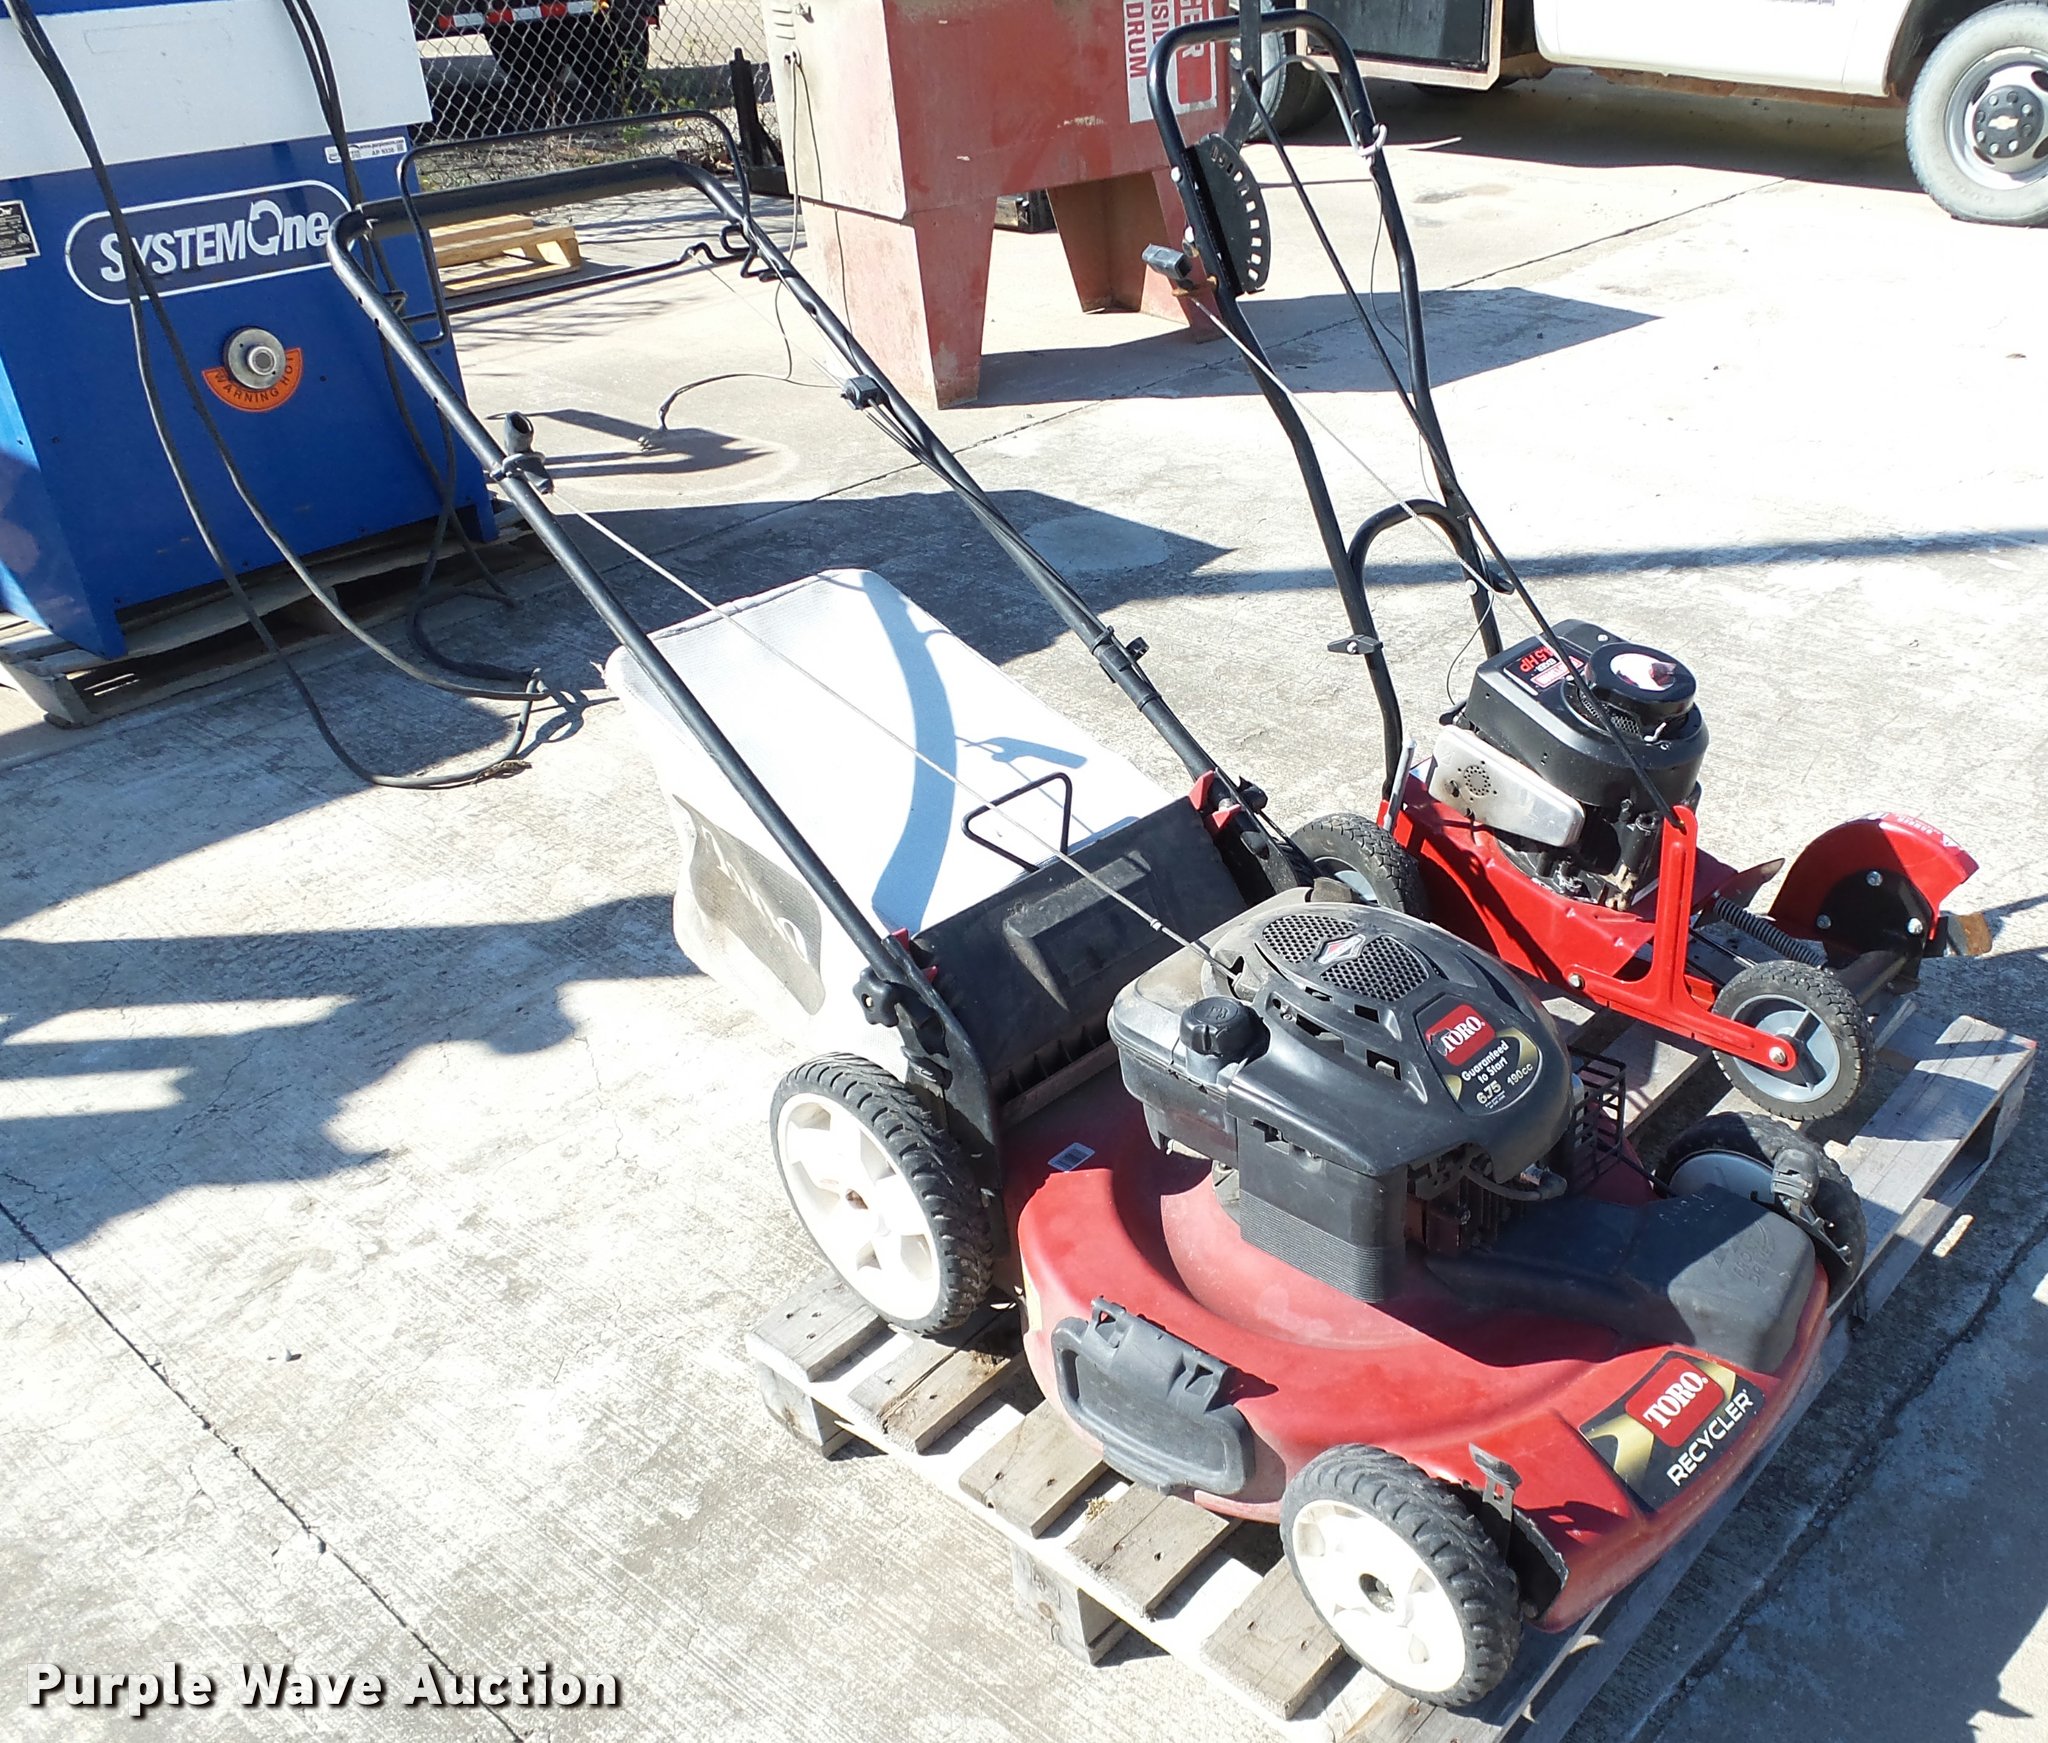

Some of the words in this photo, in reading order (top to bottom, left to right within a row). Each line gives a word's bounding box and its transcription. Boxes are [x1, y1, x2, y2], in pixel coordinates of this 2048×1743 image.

[1126, 2, 1148, 79] DRUM
[215, 370, 280, 403] WARNING
[1520, 654, 1541, 673] HP
[1440, 1016, 1482, 1054] TORO
[1461, 1040, 1510, 1081] Guaranteed
[1477, 1074, 1489, 1085] to
[1486, 1056, 1509, 1077] Start
[1507, 1063, 1534, 1086] 190cc
[1643, 1371, 1706, 1429] TORO
[1666, 1391, 1754, 1487] RECYCLER
